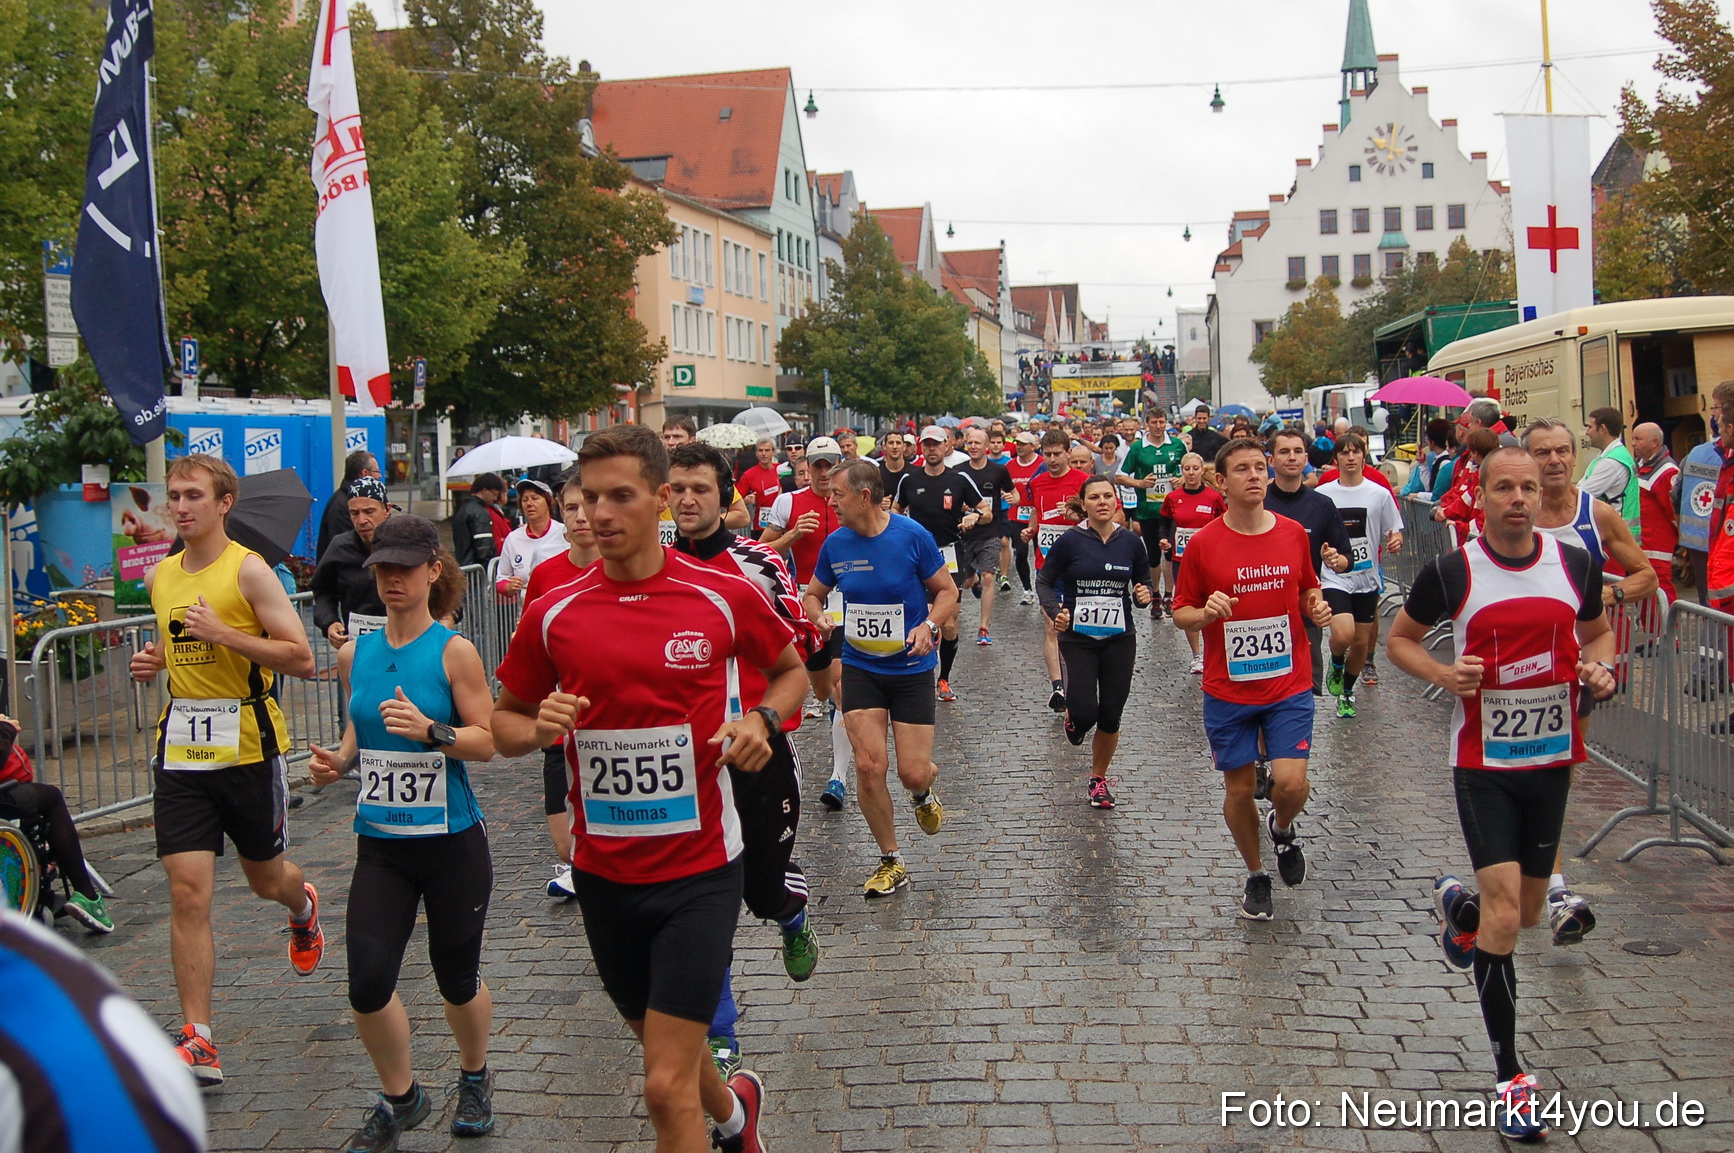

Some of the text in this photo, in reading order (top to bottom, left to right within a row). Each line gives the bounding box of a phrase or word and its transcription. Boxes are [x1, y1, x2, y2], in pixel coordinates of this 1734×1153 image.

[675, 367, 692, 384] D
[1504, 357, 1554, 385] Bayerisches
[1080, 380, 1111, 388] START
[1504, 388, 1528, 407] Rotes
[1155, 484, 1166, 494] 46
[1237, 564, 1290, 580] Klinikum
[1233, 578, 1285, 594] Neumarkt
[1079, 607, 1121, 625] 3177
[857, 618, 893, 638] 554
[1226, 623, 1280, 634] PARTL Neumarkt
[173, 642, 214, 654] HIRSCH
[1231, 631, 1287, 658] 2343
[1242, 660, 1280, 672] Thorsten
[1513, 661, 1538, 676] DEHN
[1483, 694, 1556, 706] PARTL Neumarkt
[187, 715, 212, 742] 11
[1491, 704, 1564, 738] 2273
[577, 738, 671, 751] PARTL Neumarkt
[1510, 743, 1547, 756] Rainer
[186, 749, 216, 760] Stefan
[361, 757, 430, 769] PARTL Neumarkt
[589, 752, 684, 796] 2555
[366, 771, 438, 803] 2137
[608, 805, 668, 822] Thomas
[782, 798, 791, 814] 5
[385, 811, 414, 823] Jutta
